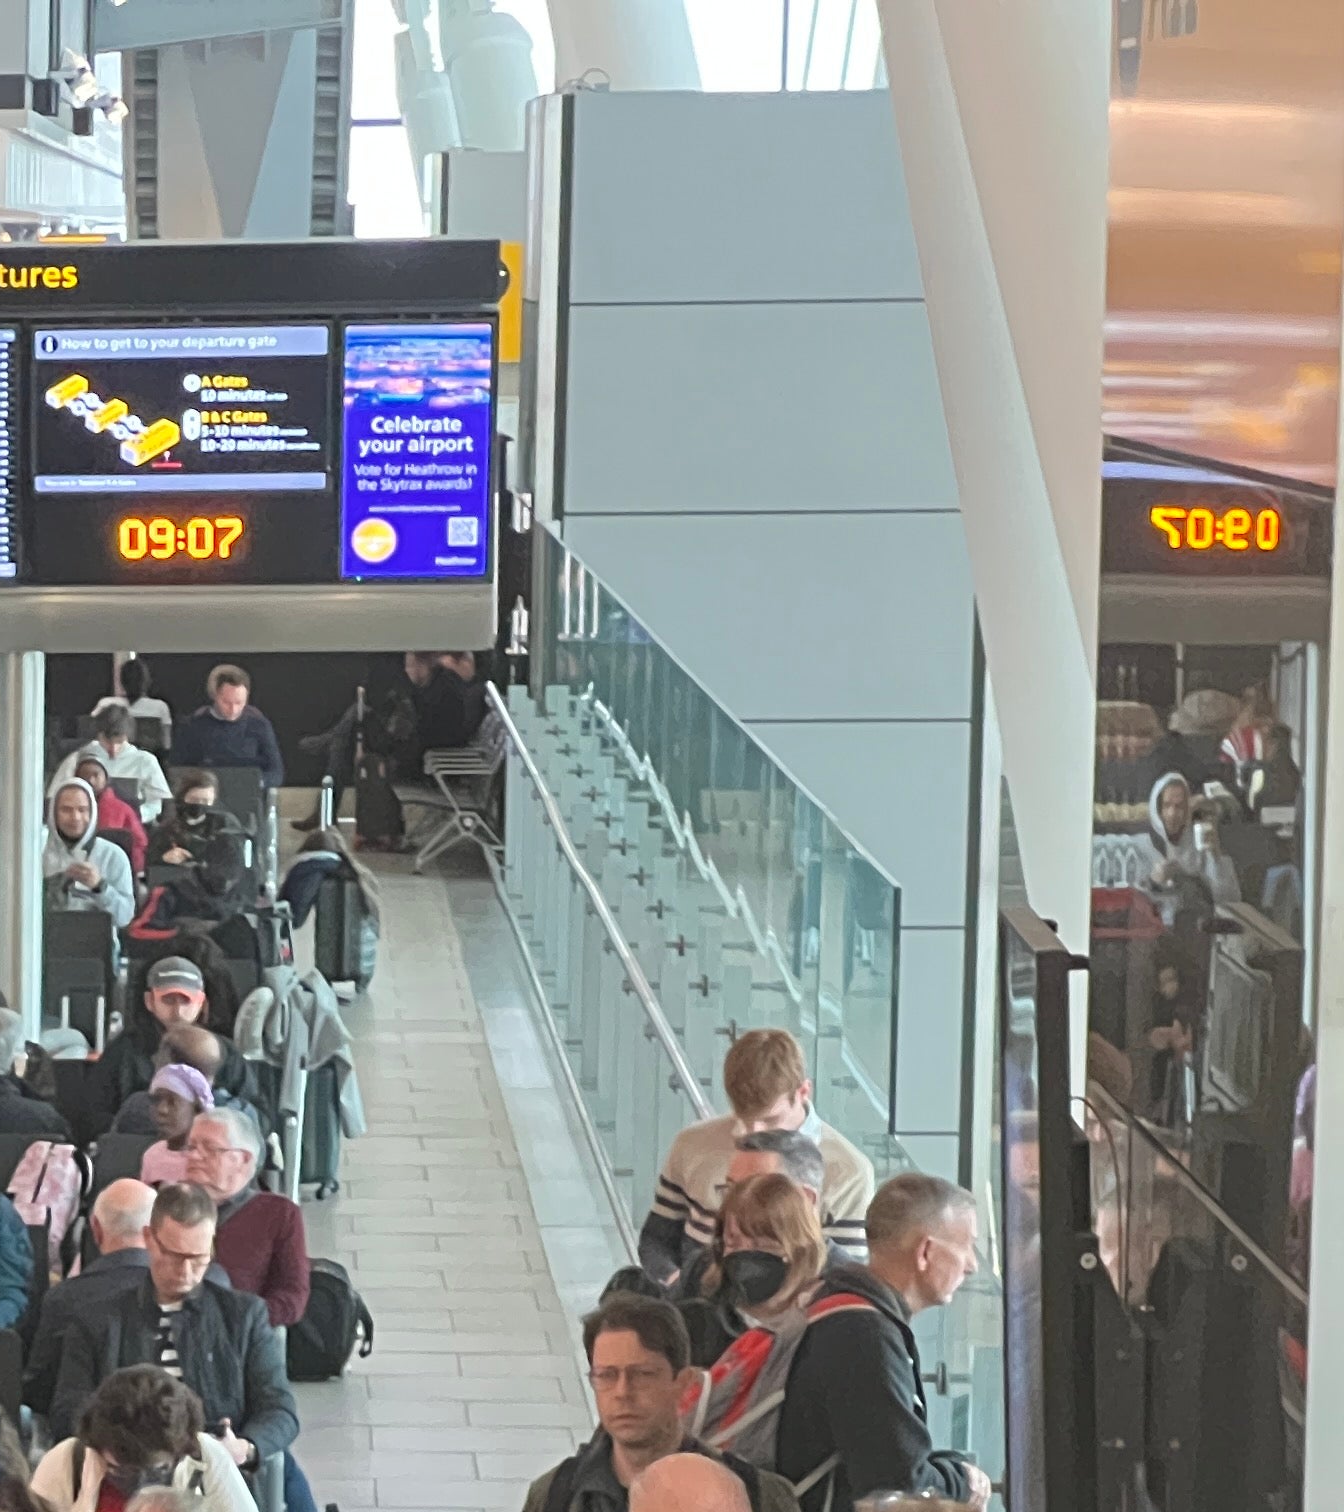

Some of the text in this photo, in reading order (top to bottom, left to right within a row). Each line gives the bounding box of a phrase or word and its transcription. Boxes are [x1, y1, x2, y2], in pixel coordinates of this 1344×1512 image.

[61, 336, 277, 352] How to get to your departure gate
[202, 376, 248, 388] A Gates
[232, 411, 268, 423] Gates
[371, 416, 462, 434] Celebrate
[359, 435, 473, 457] your airport
[354, 462, 477, 476] Vote for Heathrow in
[357, 477, 472, 493] the Skytrax awards!
[118, 517, 244, 560] 09:07
